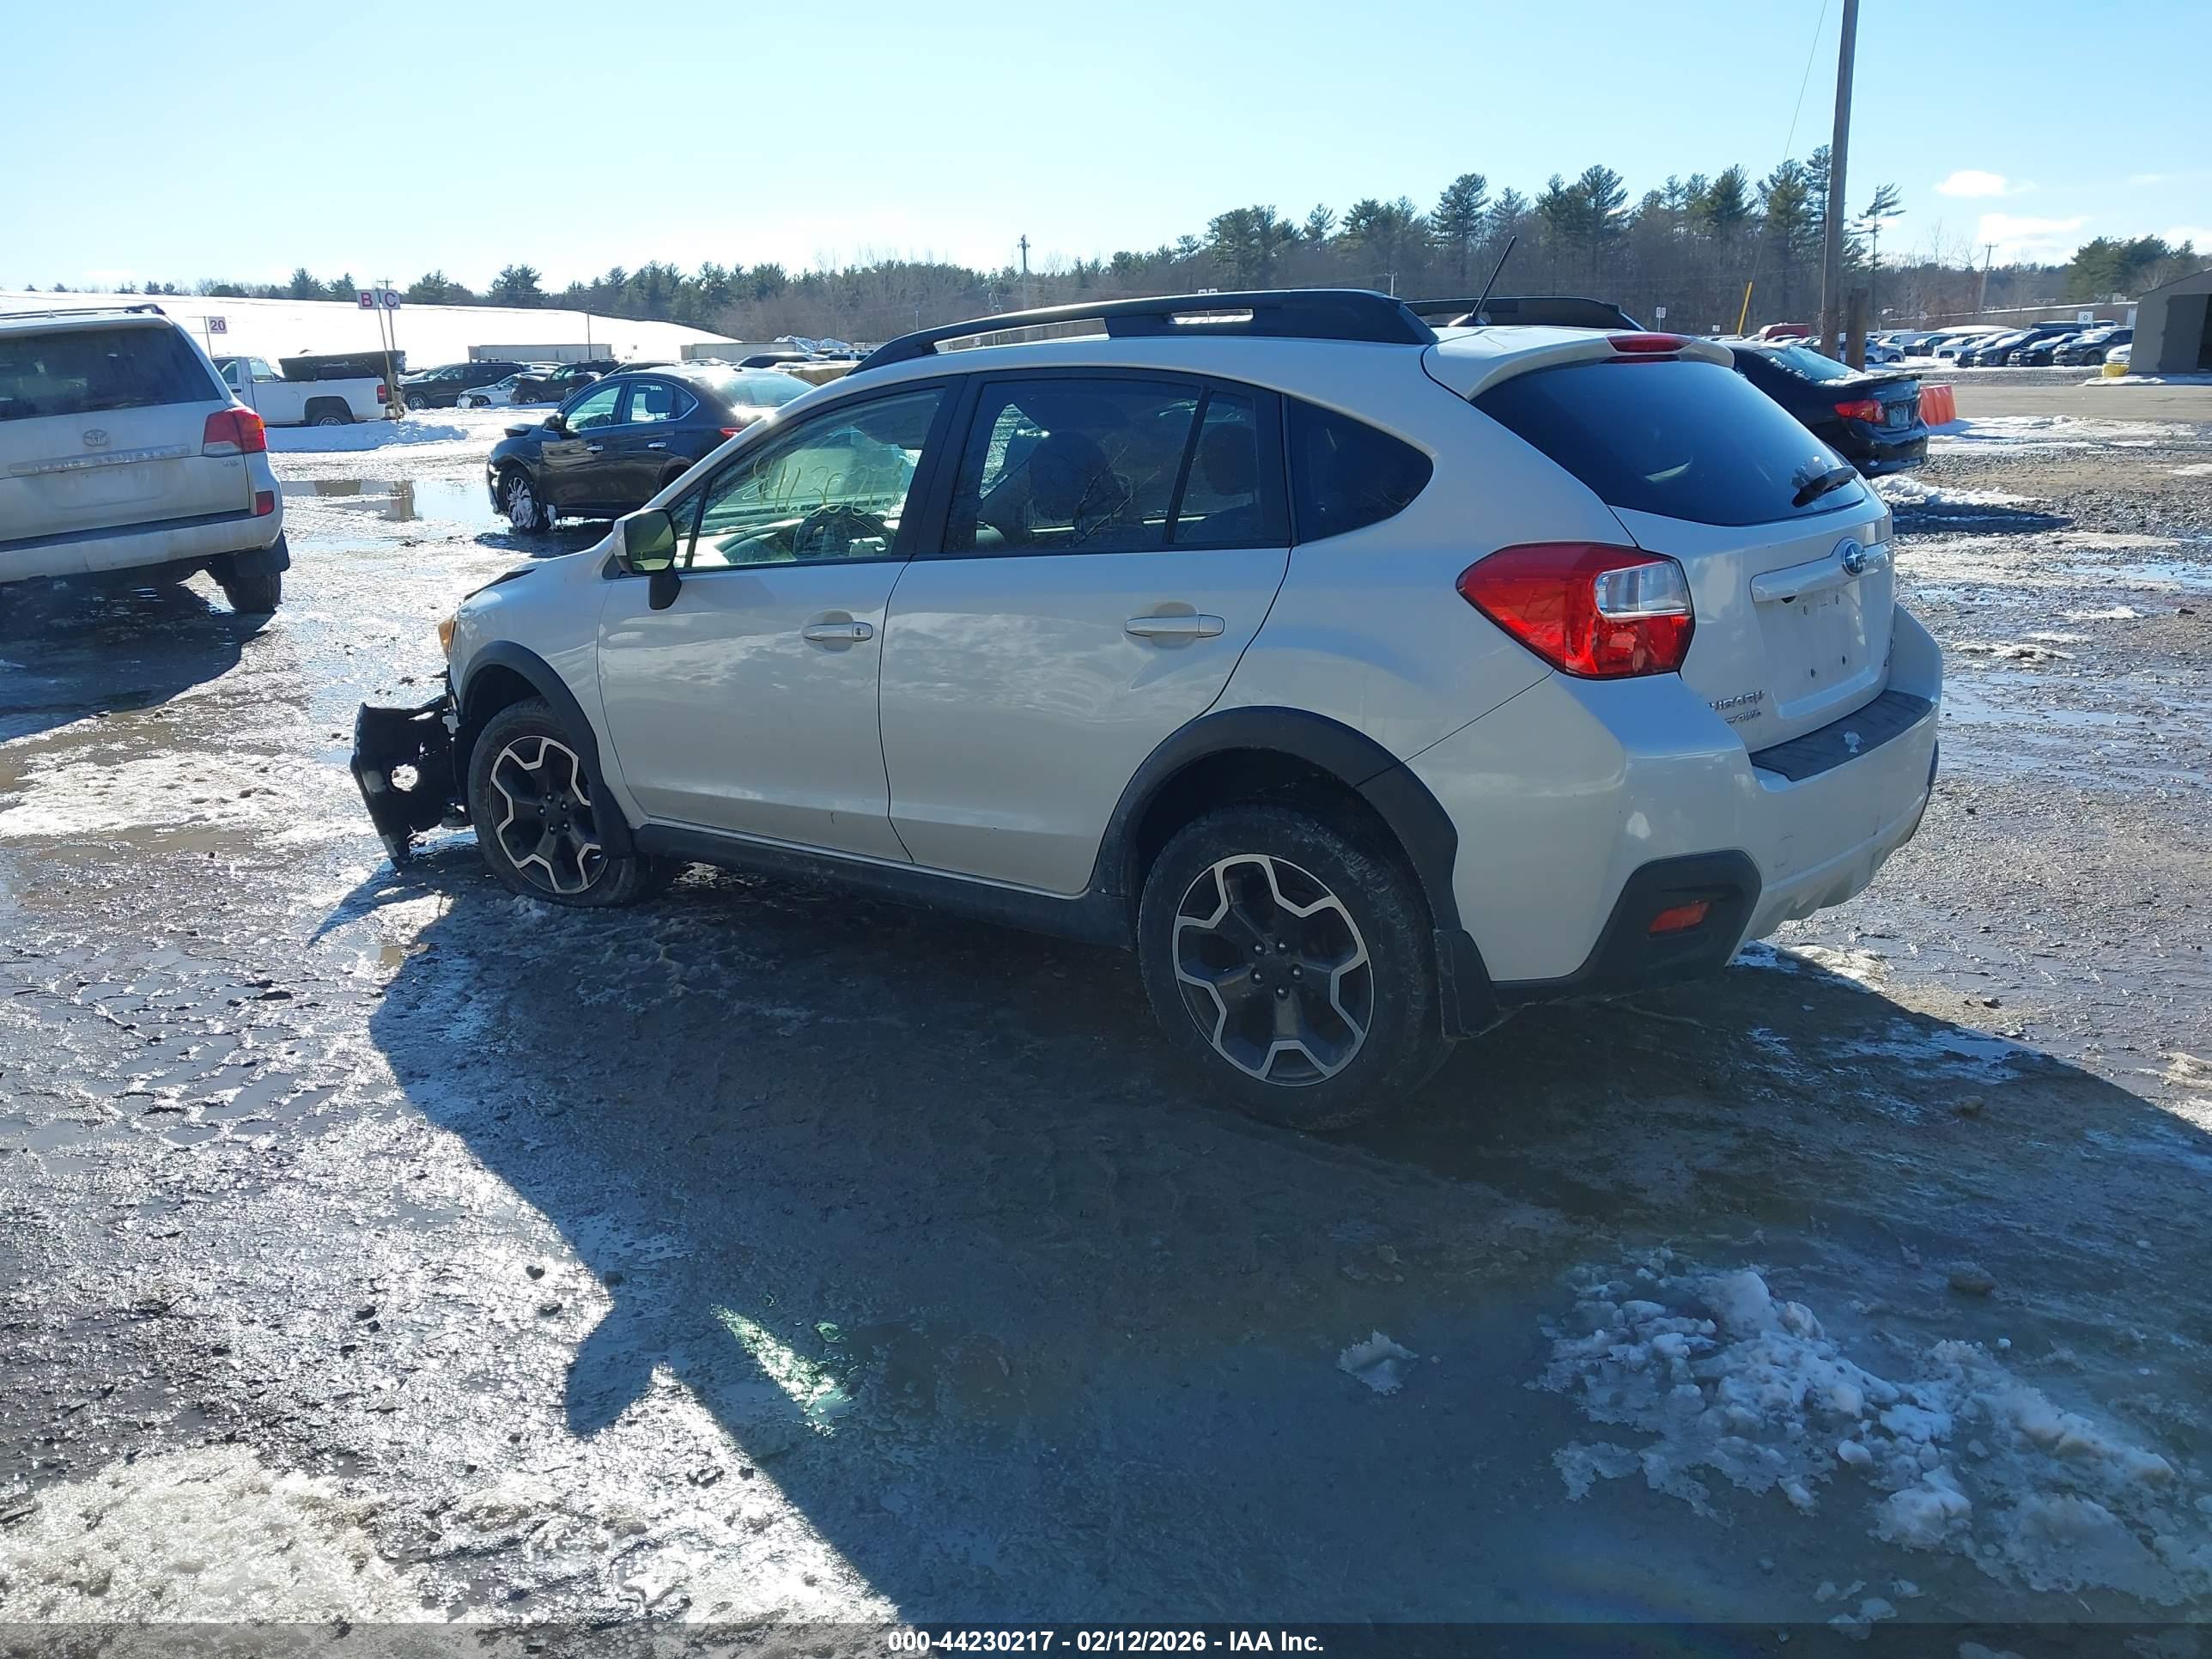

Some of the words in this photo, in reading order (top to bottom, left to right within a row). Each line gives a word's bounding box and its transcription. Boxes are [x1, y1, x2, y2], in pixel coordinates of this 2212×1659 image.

[361, 292, 374, 307] B
[384, 292, 397, 307] C
[210, 319, 226, 331] 20
[1707, 690, 1765, 711] UBARU
